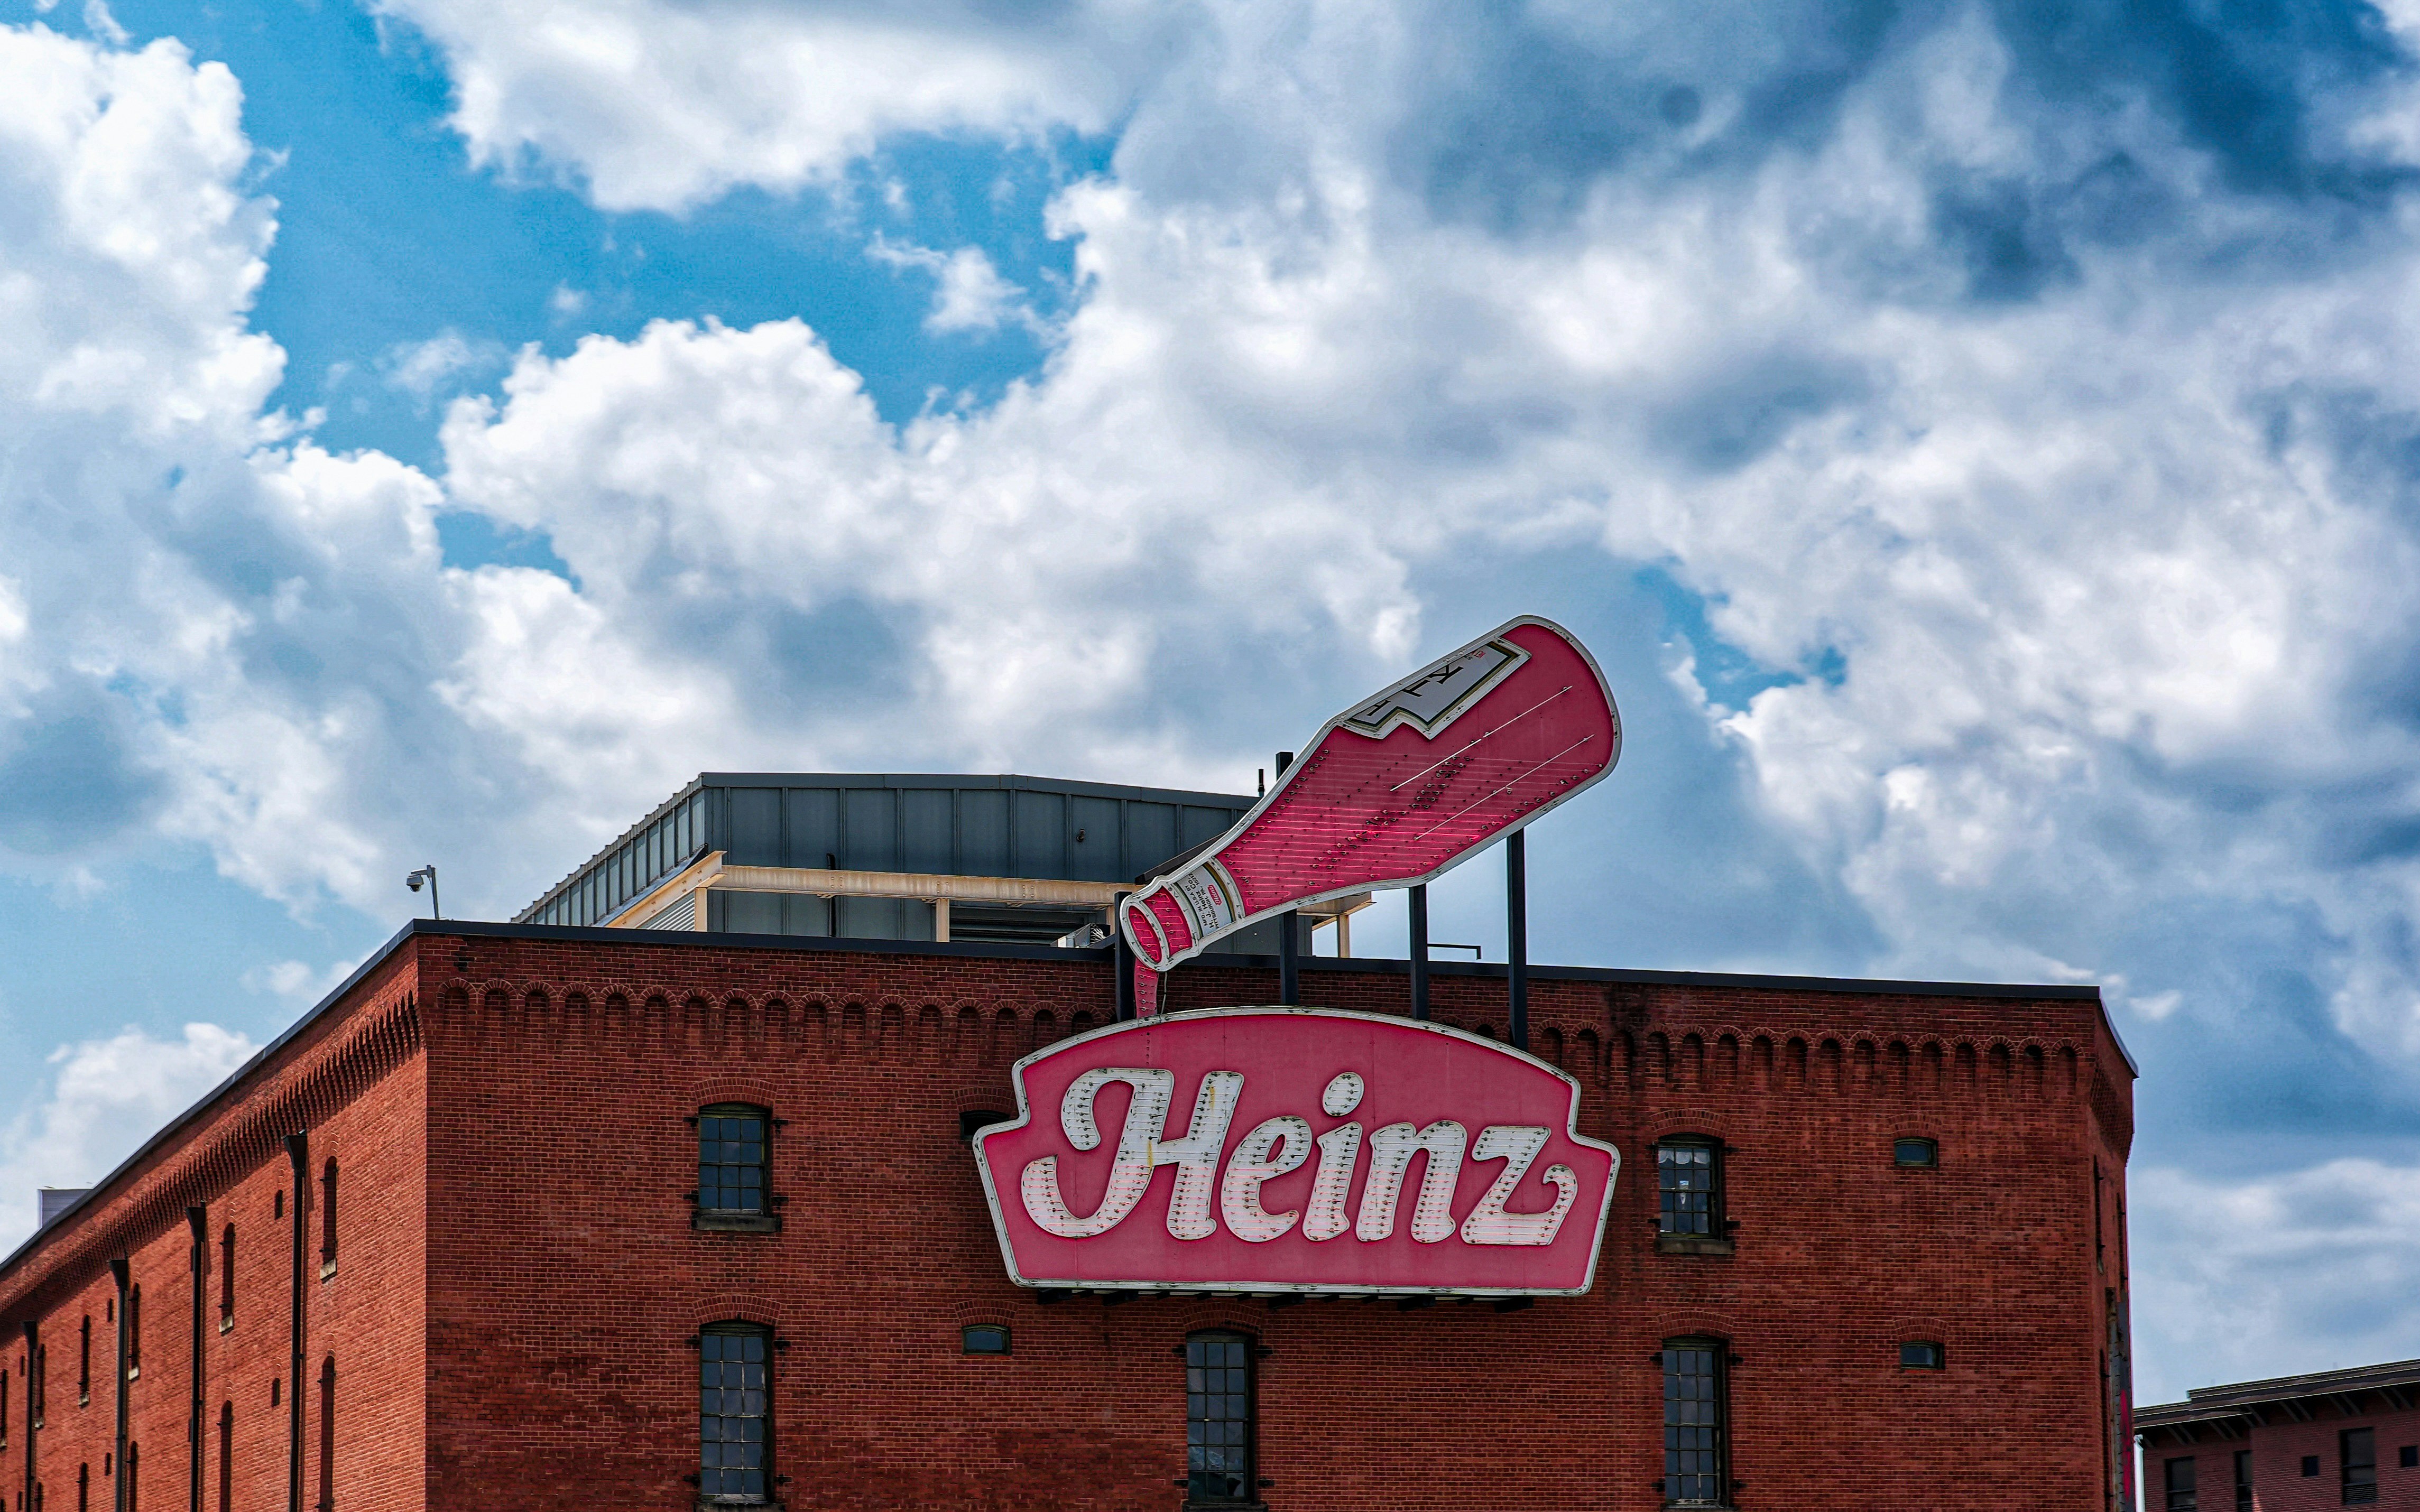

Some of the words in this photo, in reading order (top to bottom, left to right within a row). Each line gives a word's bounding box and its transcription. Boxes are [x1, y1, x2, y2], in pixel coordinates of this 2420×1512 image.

[1196, 890, 1208, 910] Heinz
[1208, 920, 1215, 929] H.
[1021, 1068, 1578, 1246] Heinz
